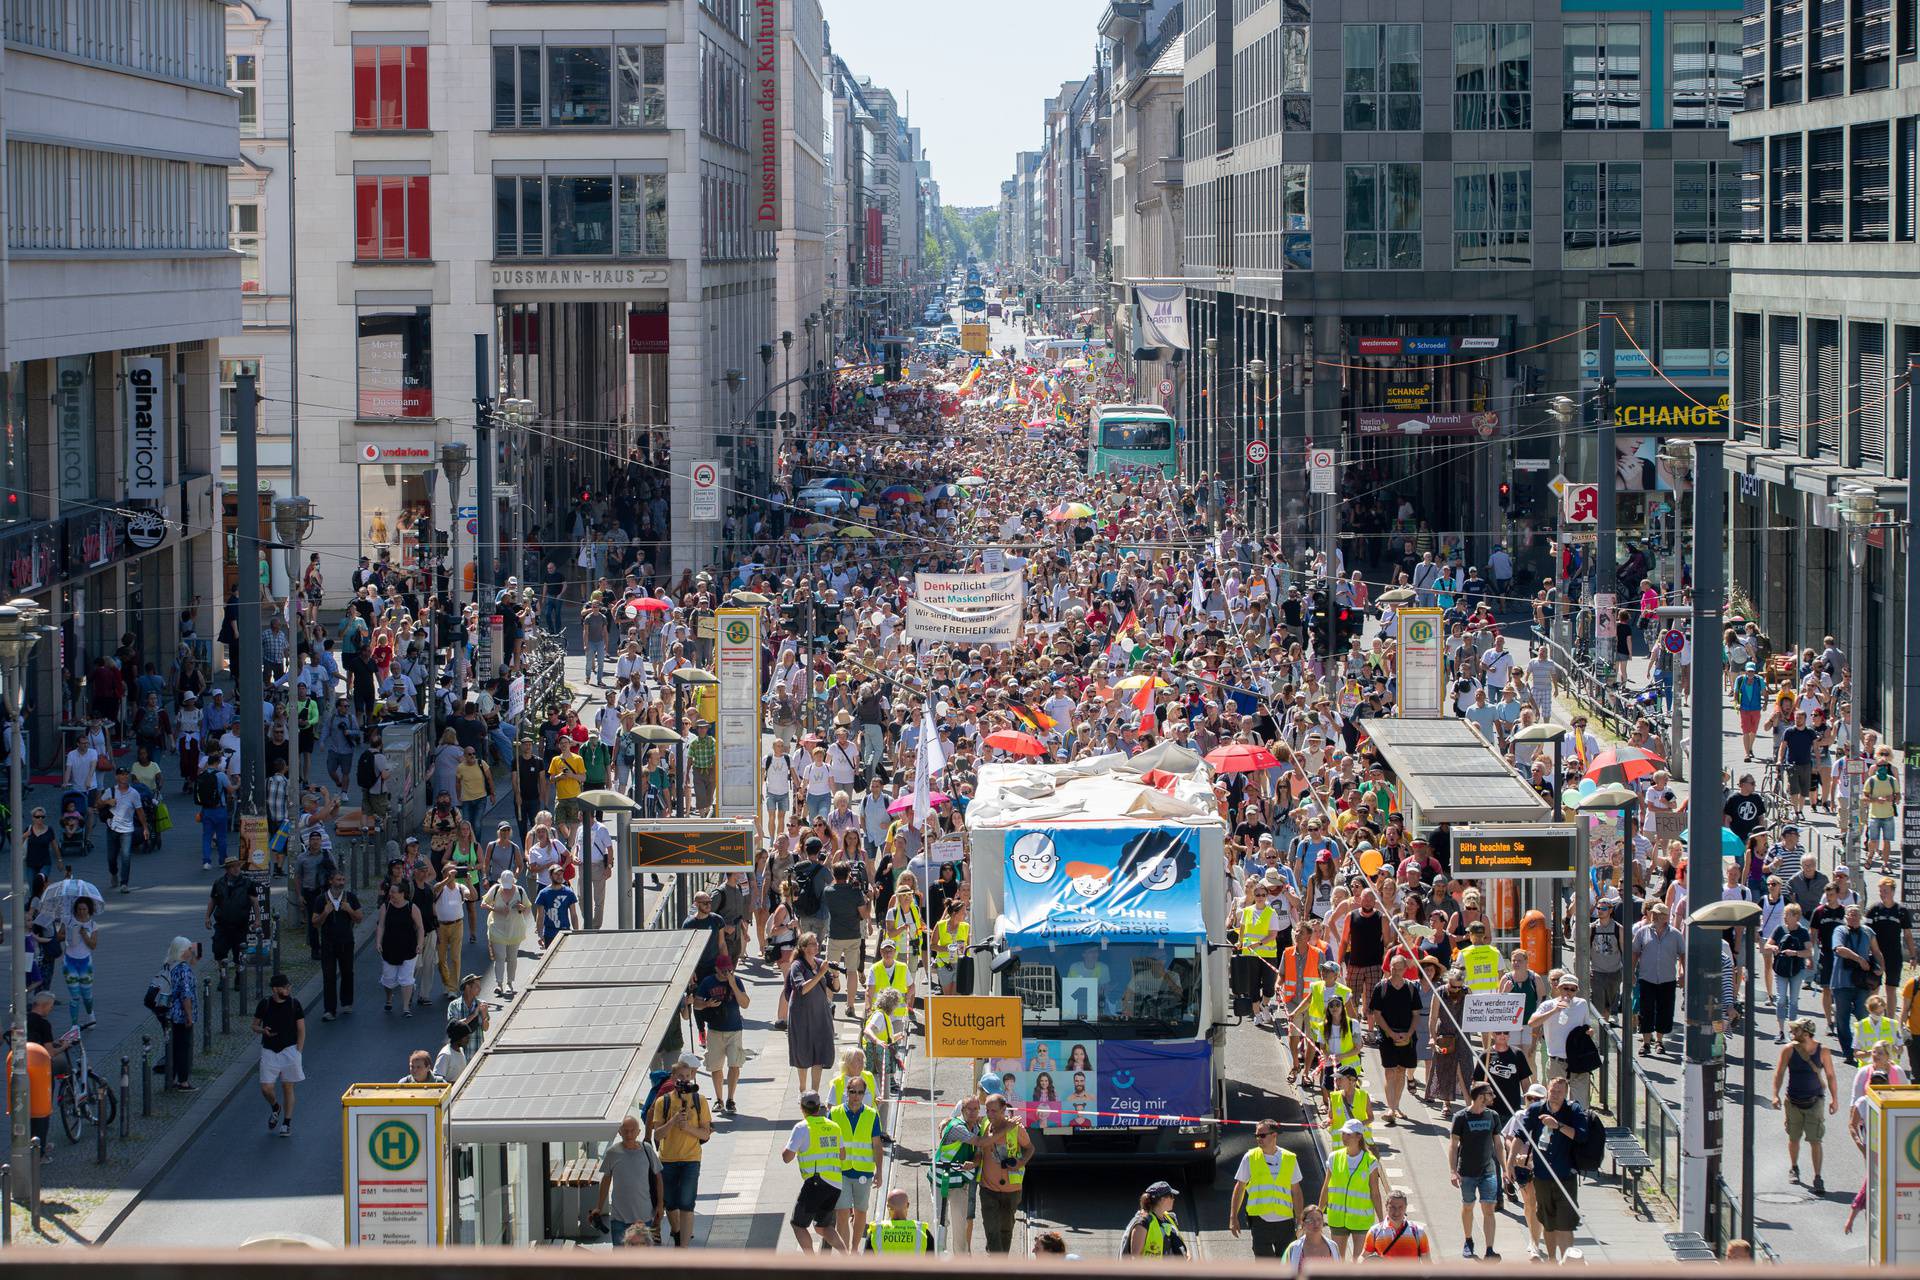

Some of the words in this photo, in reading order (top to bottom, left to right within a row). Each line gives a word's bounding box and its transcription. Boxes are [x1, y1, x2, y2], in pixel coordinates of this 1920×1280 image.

[757, 79, 775, 111] das
[757, 118, 776, 222] Dussmann
[492, 270, 635, 284] DUSSMANN-HAUS
[405, 377, 419, 385] Uhr
[372, 398, 419, 407] Dussmann
[1360, 418, 1381, 426] berlin
[1426, 415, 1461, 424] Mmmh!
[1360, 425, 1381, 433] tapas
[382, 448, 429, 457] vodafone
[1251, 446, 1264, 458] 30
[1740, 472, 1760, 497] DEPOT
[924, 581, 986, 592] Denkpflicht
[924, 595, 945, 604] statt
[947, 593, 1015, 604] Maskenpflicht
[915, 608, 928, 616] Wir
[914, 623, 941, 633] unsere
[943, 624, 987, 635] FREIHEIT
[1415, 626, 1427, 639] H
[1460, 843, 1477, 852] Bitte
[1480, 843, 1511, 852] beachten
[1513, 842, 1525, 852] Sie
[1460, 856, 1472, 865] den
[1475, 855, 1532, 867] Fahrplanaushang
[1101, 921, 1170, 936] Maske
[1070, 986, 1089, 1020] 1
[1472, 999, 1483, 1007] Wir
[1485, 999, 1506, 1007] werden
[1507, 999, 1519, 1007] eure
[942, 1011, 1006, 1030] Stuttgart
[1467, 1014, 1487, 1023] niemals
[942, 1037, 956, 1046] Ruf
[957, 1037, 969, 1046] der
[971, 1037, 1008, 1046] Trommeln
[1111, 1097, 1141, 1113] Zeig
[1145, 1097, 1167, 1110] mir
[1111, 1114, 1140, 1126] Dein
[382, 1132, 406, 1160] H
[883, 1235, 914, 1243] POLIZEI
